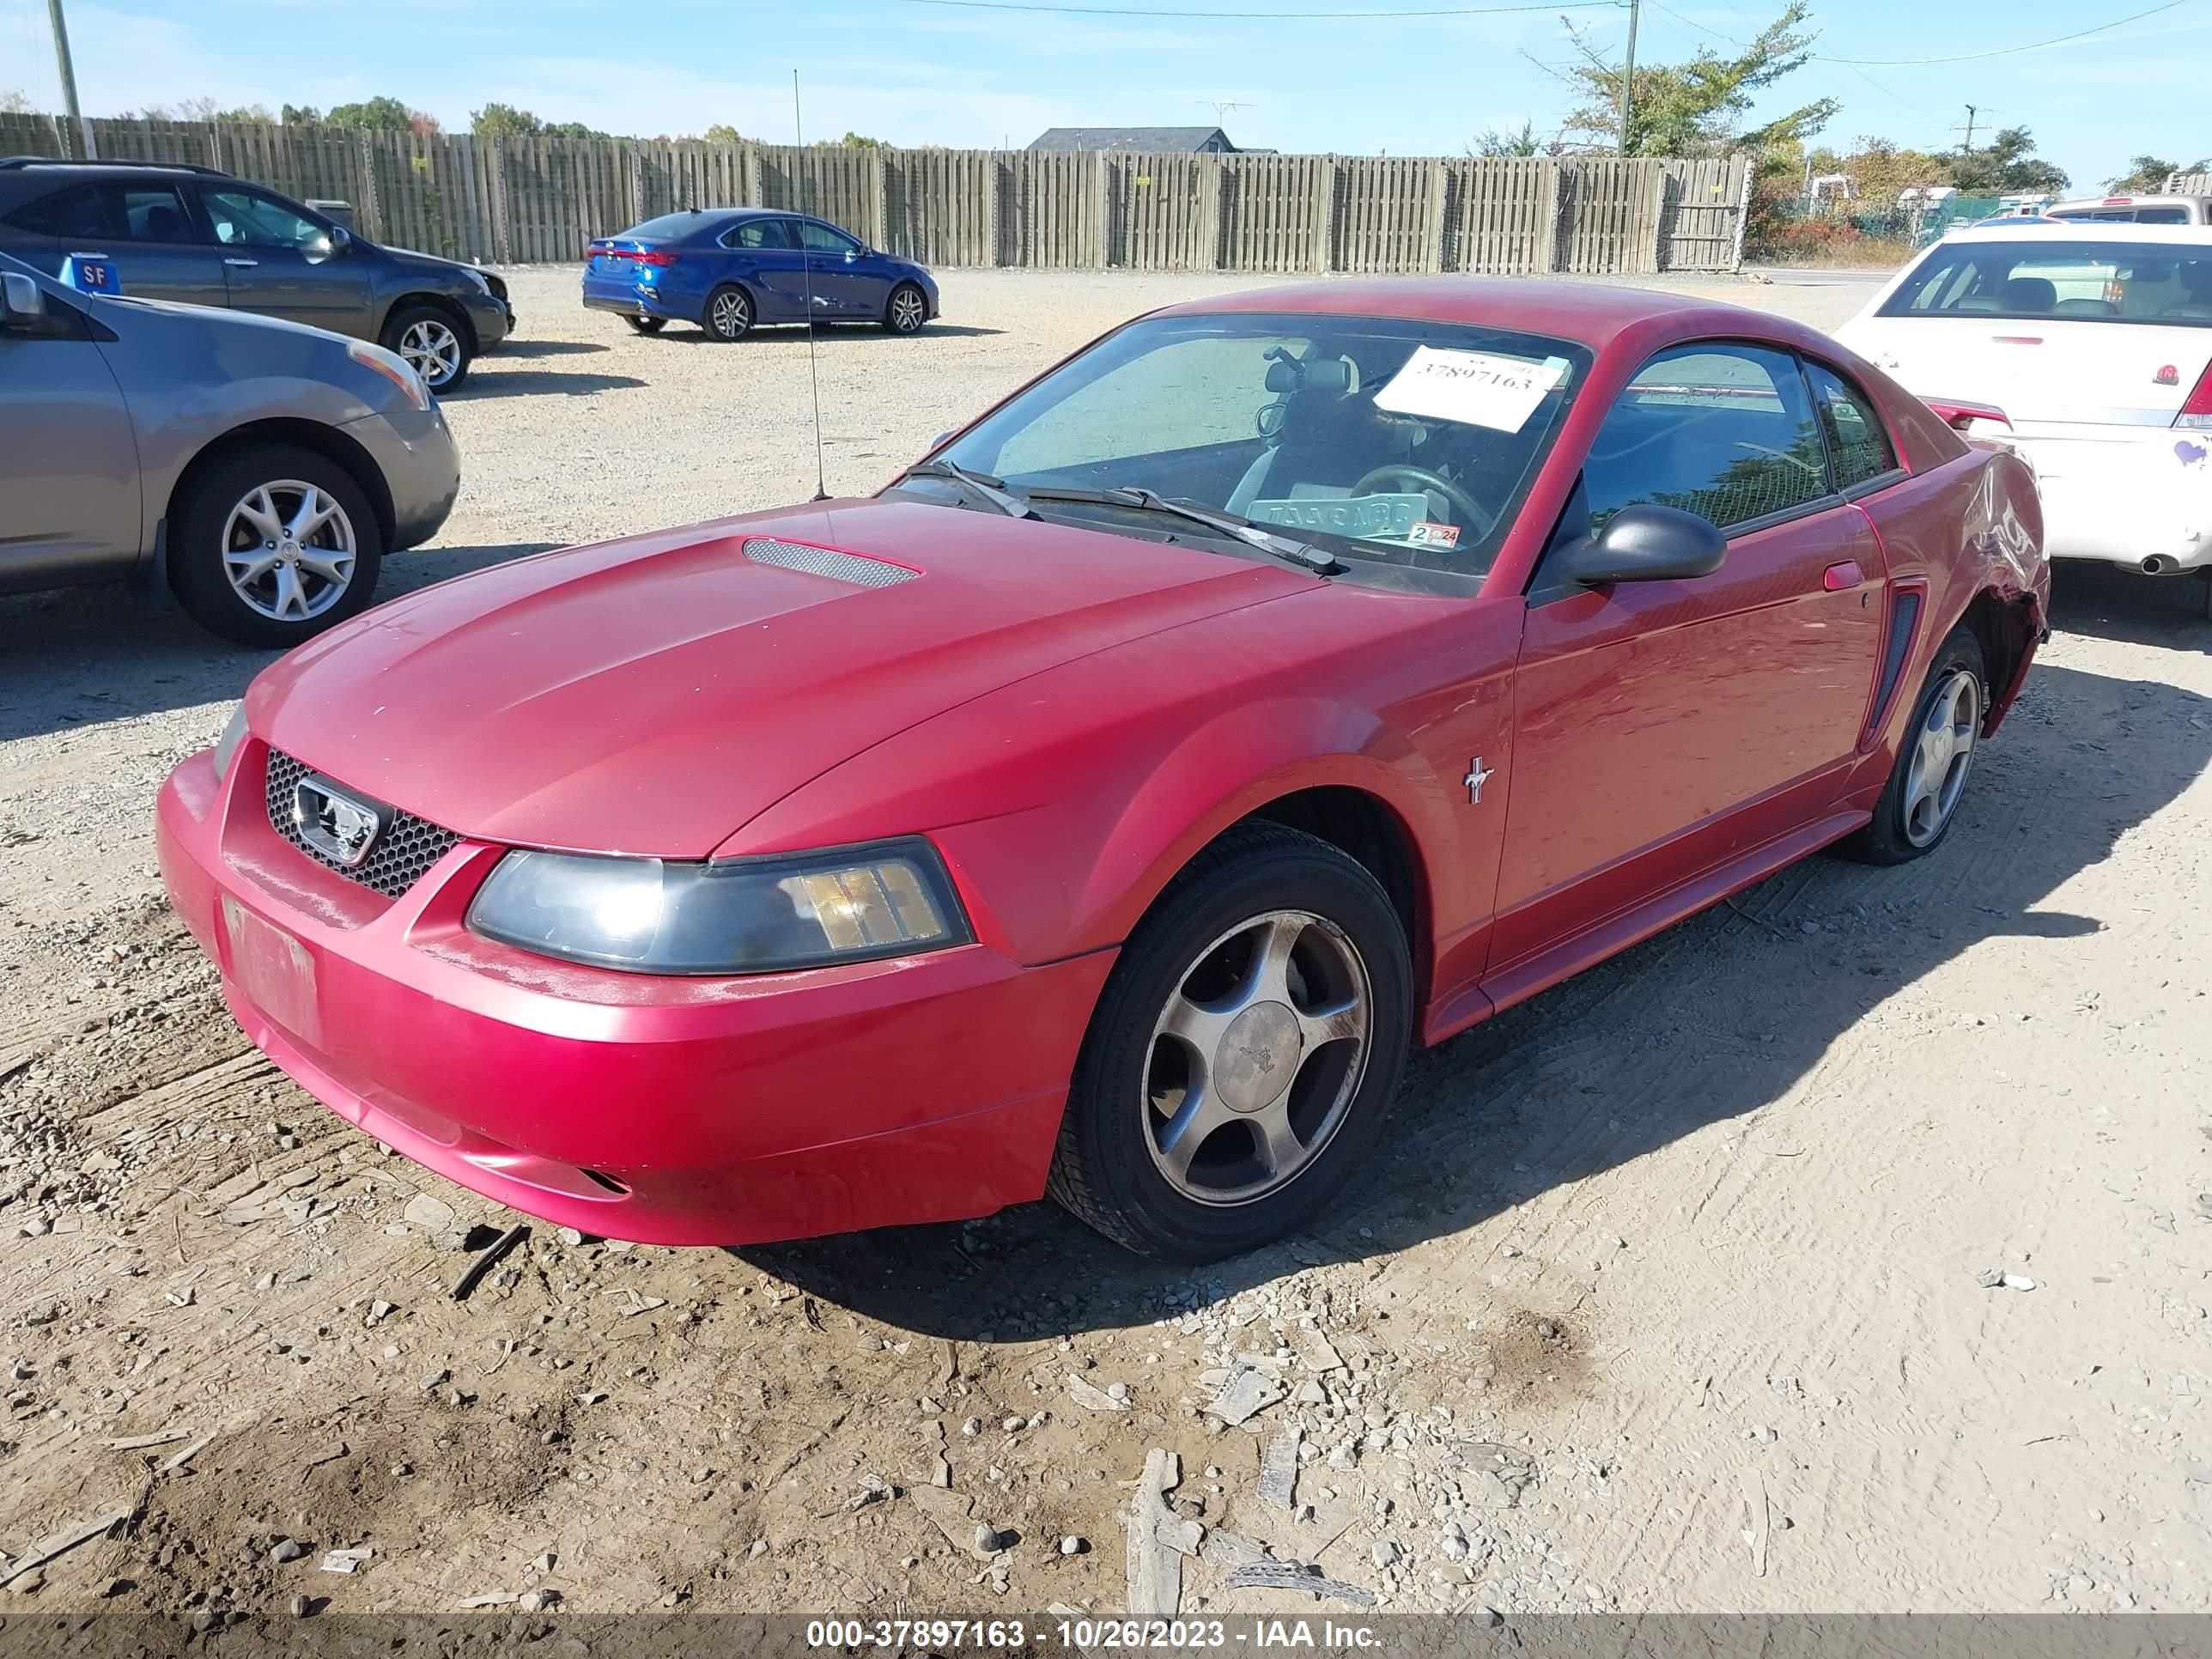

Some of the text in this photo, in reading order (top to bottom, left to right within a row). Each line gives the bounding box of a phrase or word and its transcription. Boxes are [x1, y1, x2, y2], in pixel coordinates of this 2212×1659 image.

[83, 265, 105, 284] SF
[1417, 362, 1533, 391] 37897163
[1413, 527, 1456, 541] 2 24
